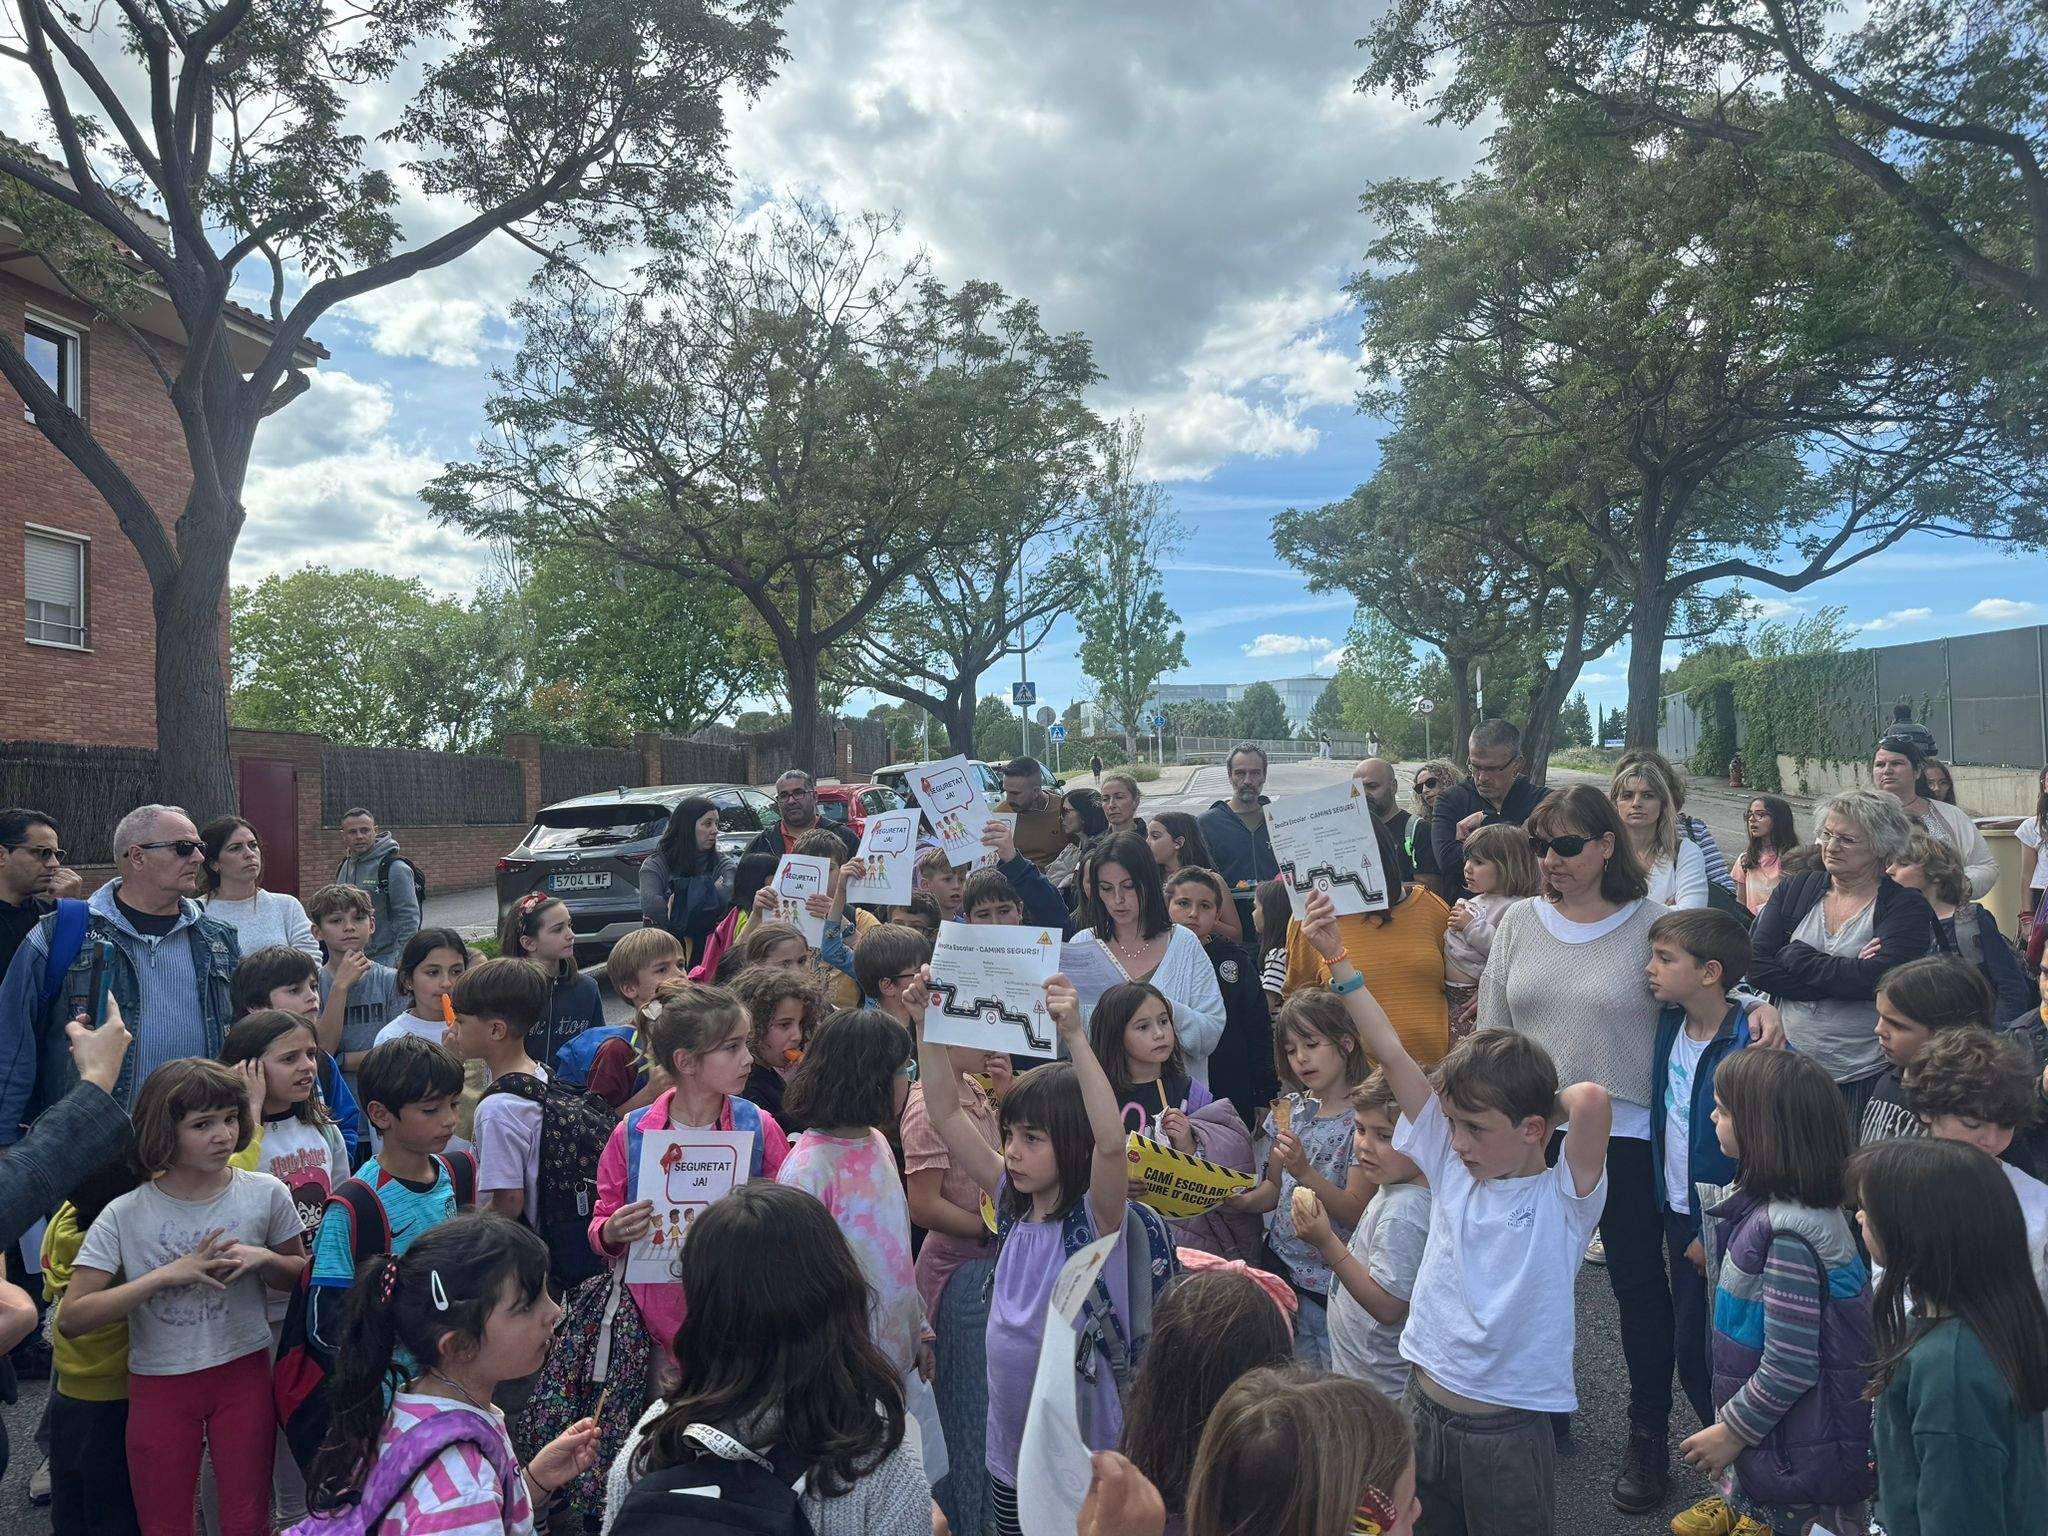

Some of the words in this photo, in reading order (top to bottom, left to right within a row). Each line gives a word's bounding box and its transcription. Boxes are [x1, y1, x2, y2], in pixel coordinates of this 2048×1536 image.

[929, 776, 964, 795] SEGURETAT
[945, 792, 956, 801] JA!
[1309, 808, 1333, 820] CAMINS
[1332, 803, 1356, 815] SEGURS!
[876, 827, 908, 835] SEGURETAT
[556, 874, 584, 887] 5704
[587, 873, 609, 886] LWF
[785, 872, 818, 882] SEGURETAT
[953, 944, 974, 952] Escolar
[979, 946, 1006, 954] CAMINS
[1006, 947, 1040, 955] SEGURS!
[298, 1147, 327, 1166] Potter
[674, 1162, 732, 1172] SEGURETAT
[692, 1177, 708, 1186] JA!
[1144, 1167, 1174, 1185] CAMÍ
[1175, 1178, 1228, 1197] ESCOLAR!
